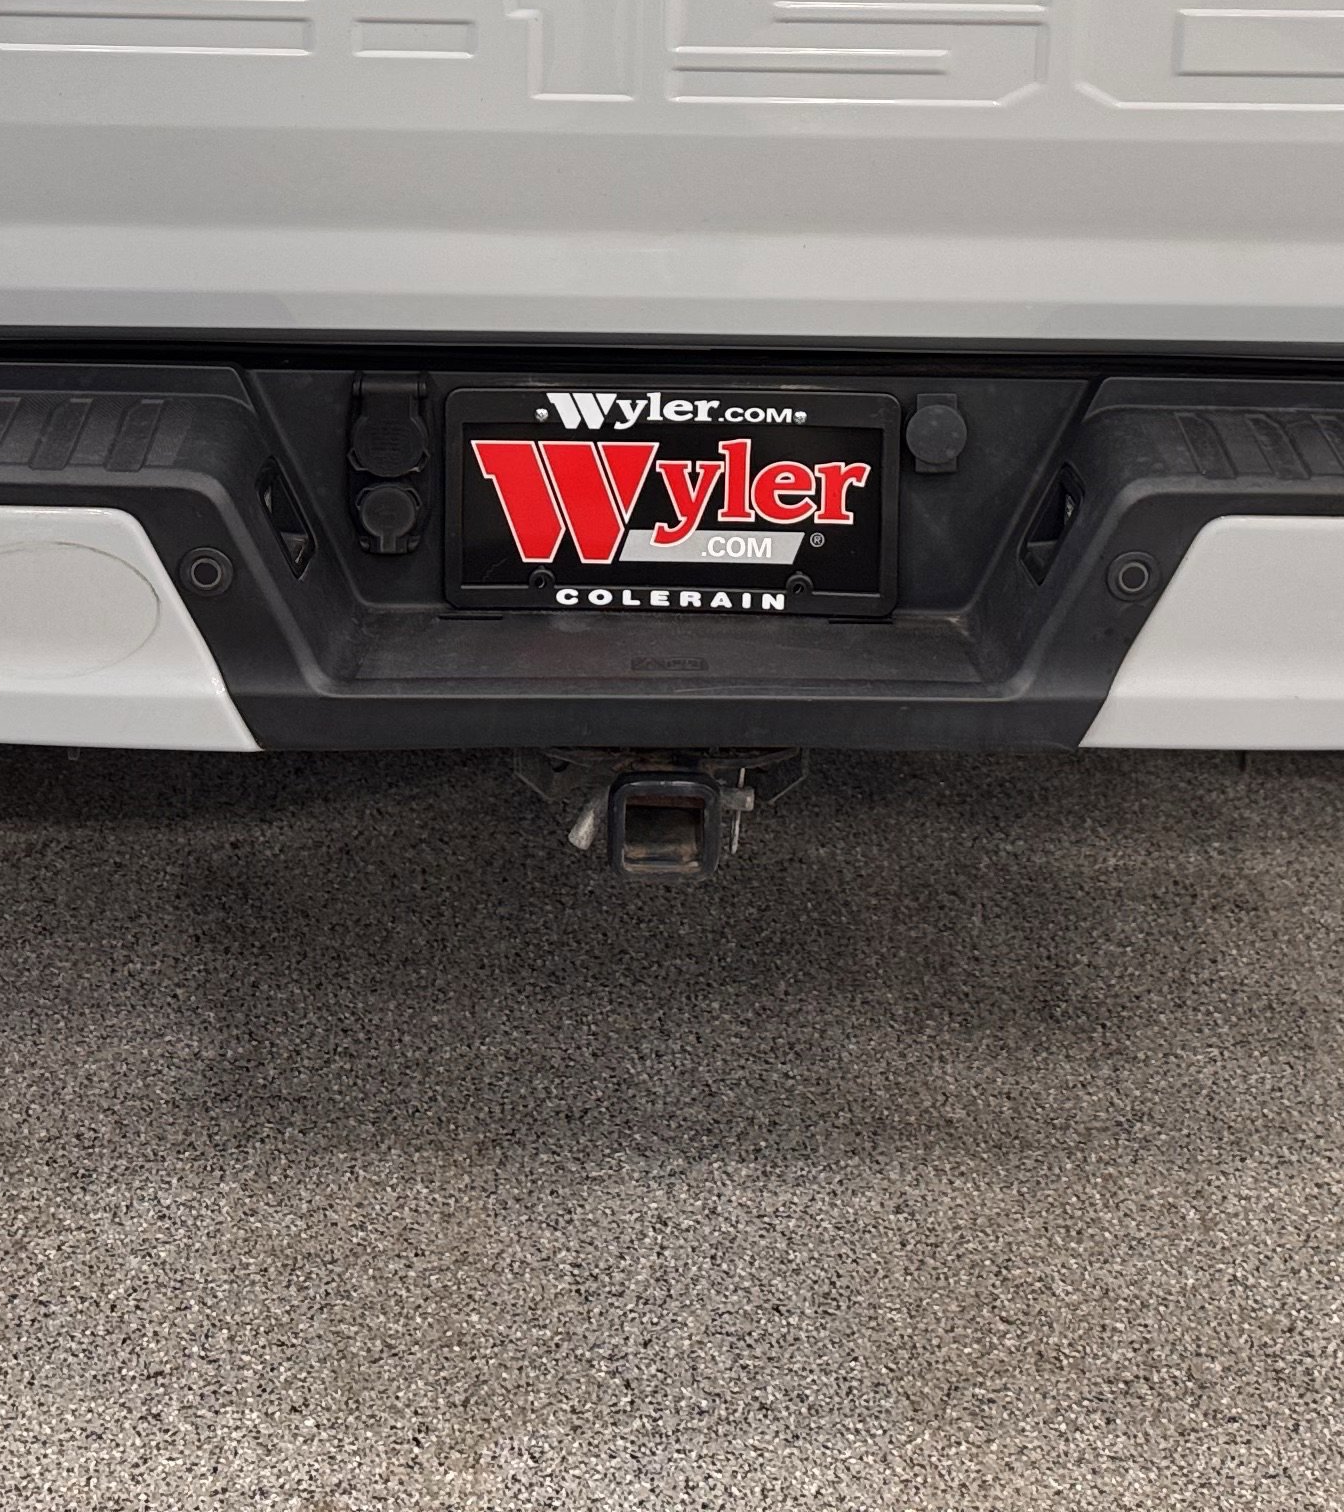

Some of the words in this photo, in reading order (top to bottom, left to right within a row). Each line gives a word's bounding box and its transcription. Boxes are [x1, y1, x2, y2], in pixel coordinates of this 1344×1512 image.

[471, 439, 871, 564] Wyler
[701, 536, 772, 558] .COM
[556, 588, 785, 610] COLERAIN
